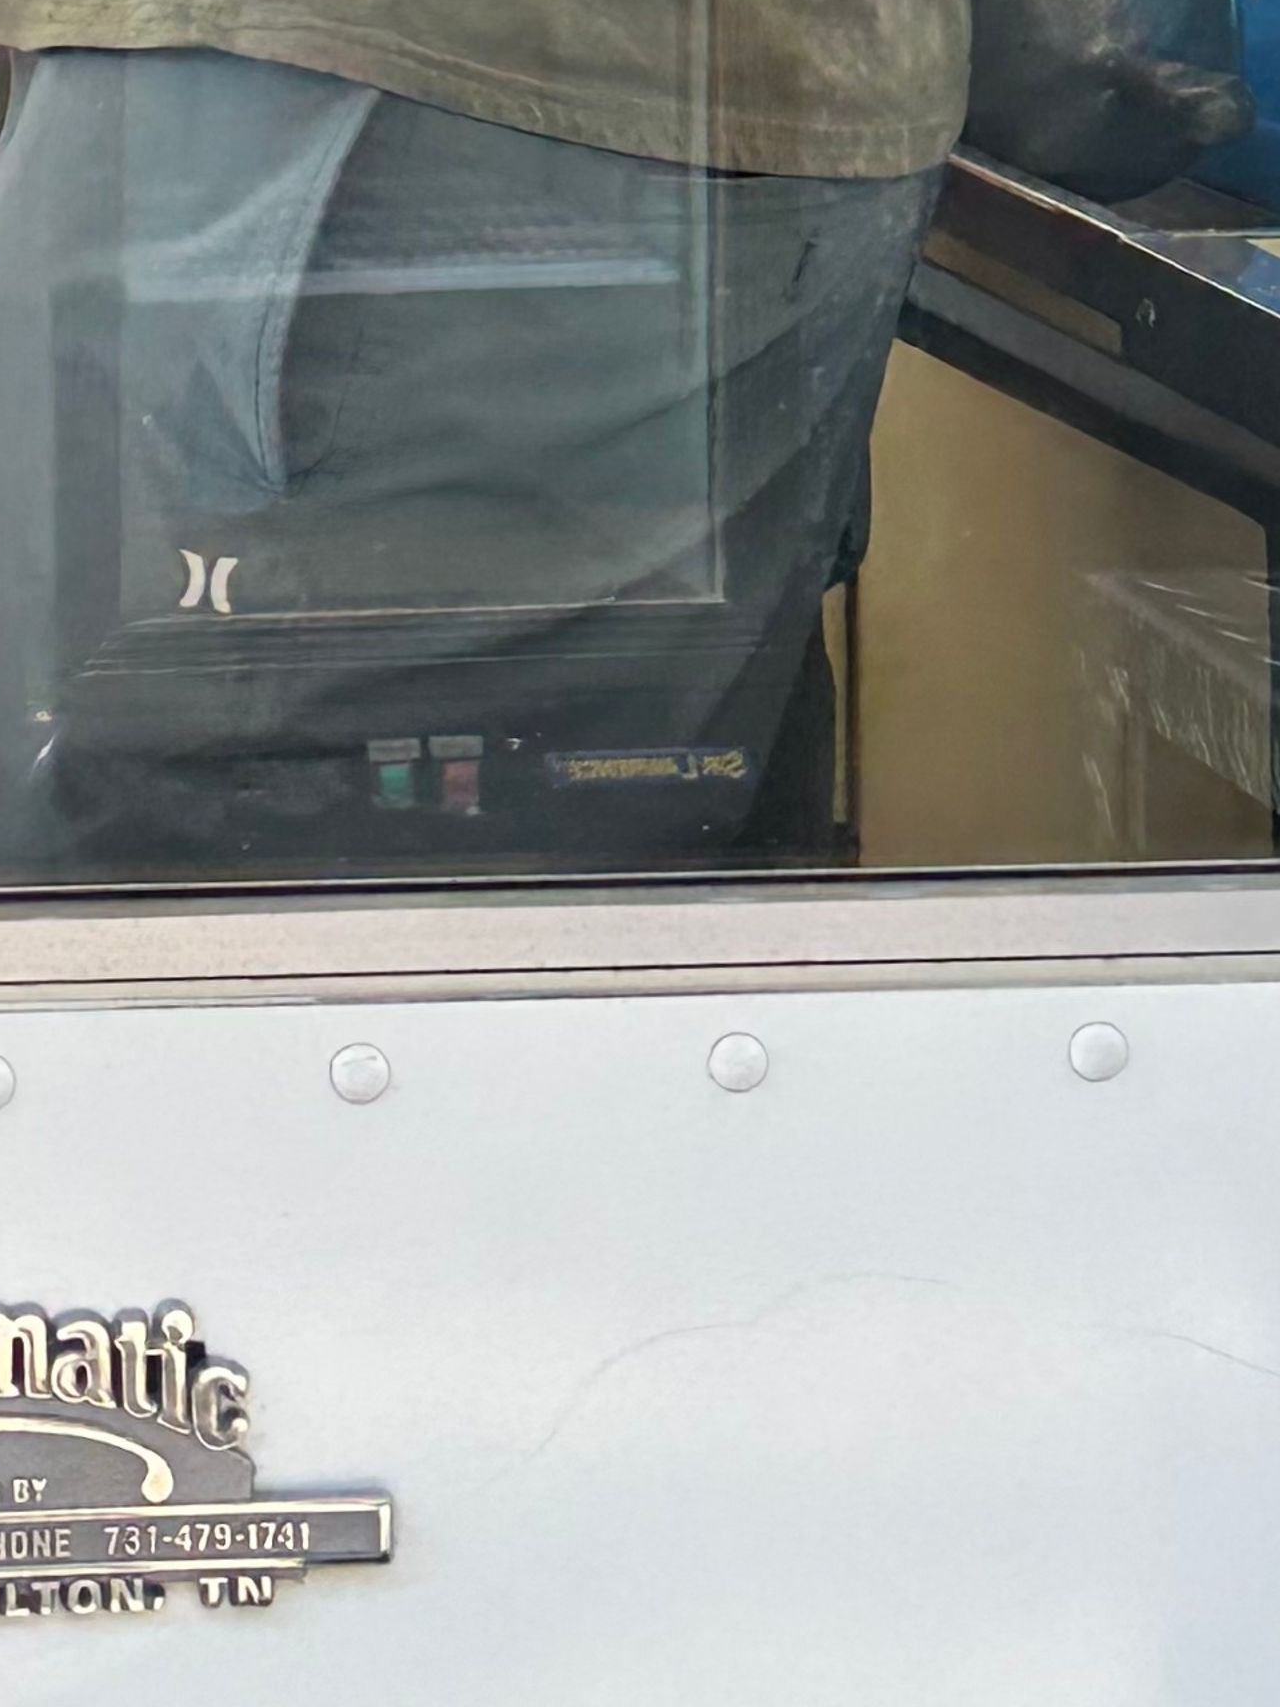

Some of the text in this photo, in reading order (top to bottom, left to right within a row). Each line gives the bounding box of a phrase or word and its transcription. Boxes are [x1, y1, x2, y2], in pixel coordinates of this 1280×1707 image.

[13, 1476, 48, 1504] BY
[104, 1521, 311, 1556] 731-479-1741
[197, 1575, 276, 1608] TN
